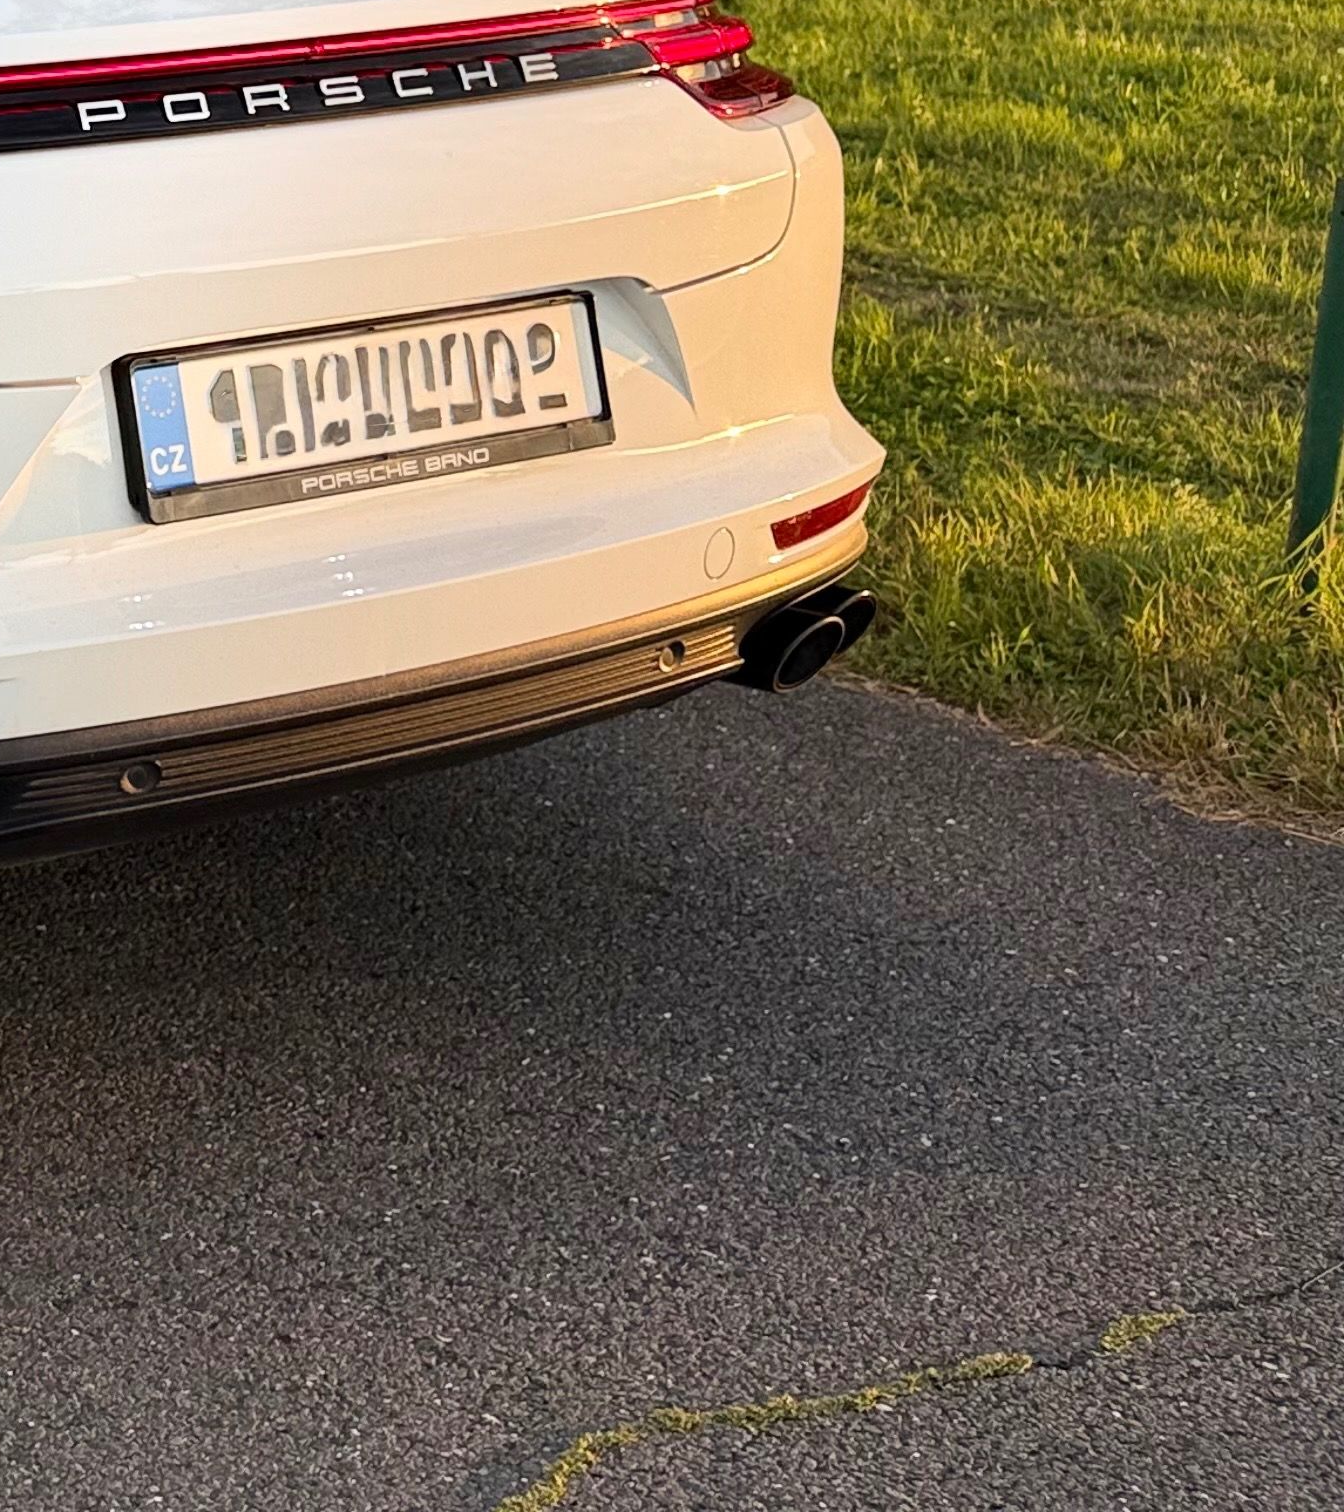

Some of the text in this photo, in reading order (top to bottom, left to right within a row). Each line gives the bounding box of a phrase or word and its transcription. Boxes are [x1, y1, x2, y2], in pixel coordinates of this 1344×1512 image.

[76, 52, 560, 131] PORSCHE
[150, 444, 188, 475] CZ
[300, 447, 490, 494] PORSCHE BRNO
